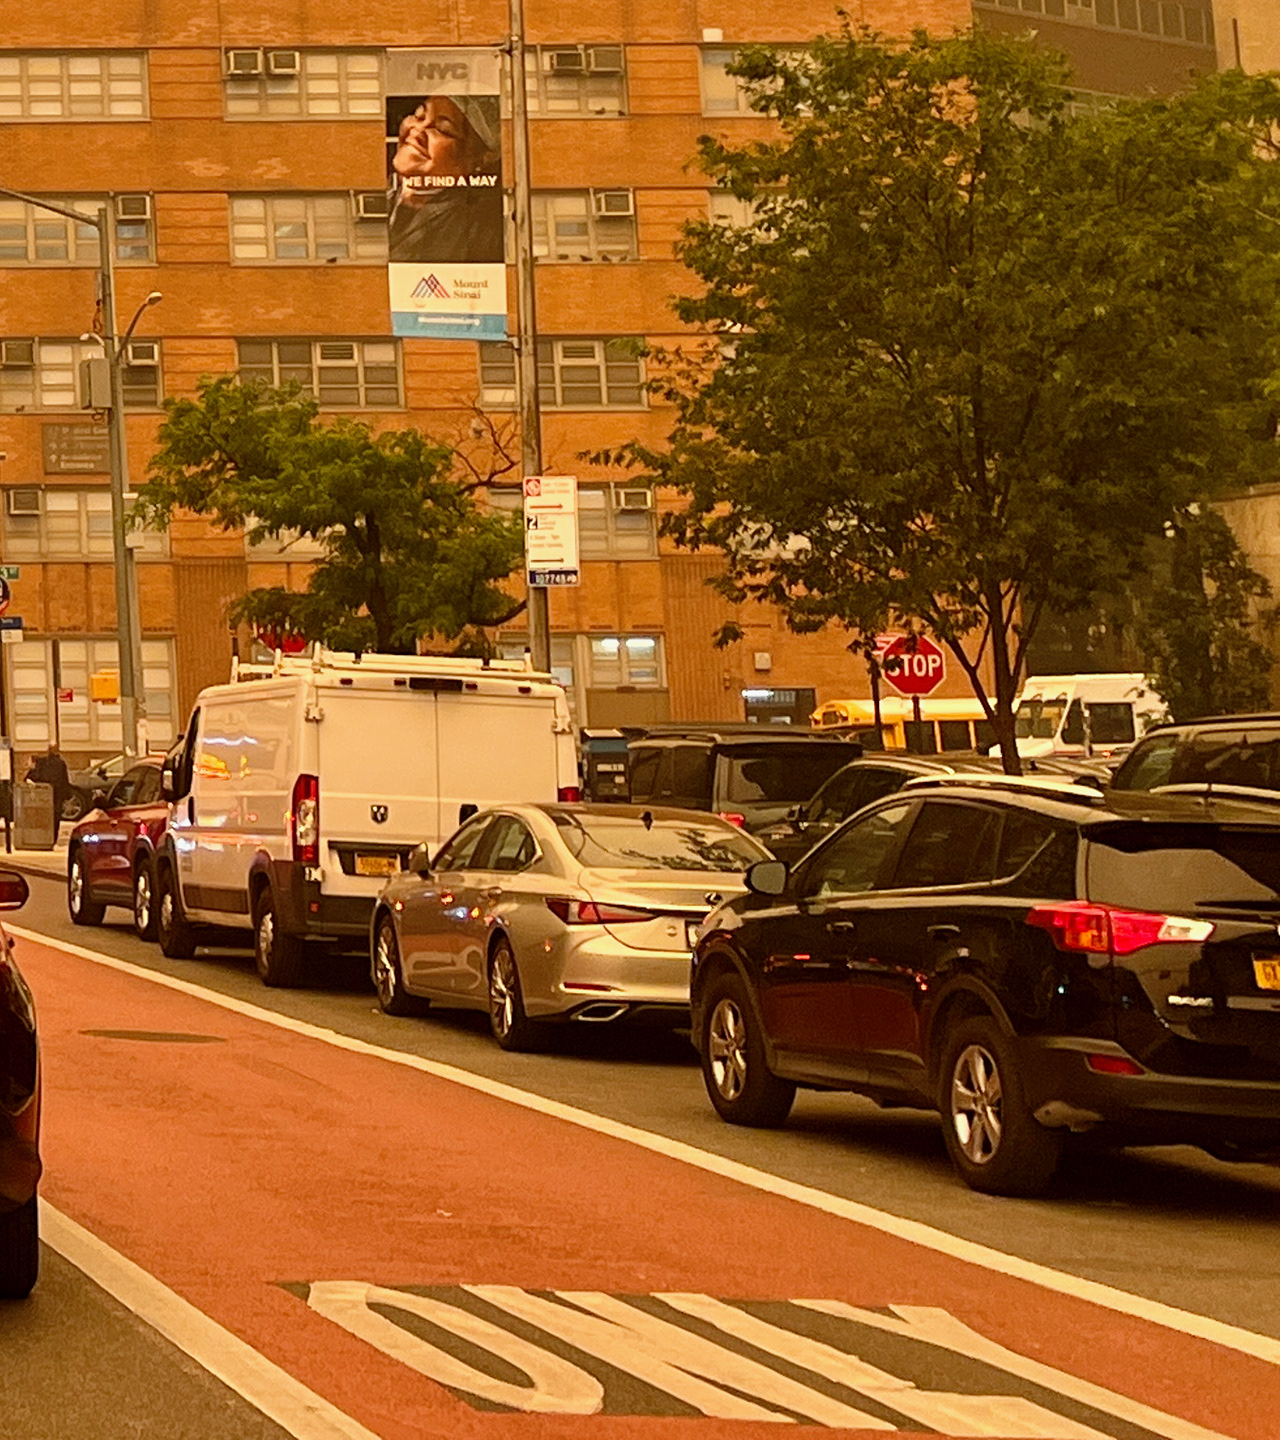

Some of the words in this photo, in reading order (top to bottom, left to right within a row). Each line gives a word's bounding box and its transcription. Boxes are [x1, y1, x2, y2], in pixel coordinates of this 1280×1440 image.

[417, 63, 468, 80] NYC
[402, 175, 422, 187] WE
[424, 176, 455, 187] FIND
[457, 176, 468, 187] A
[469, 175, 498, 187] WAY
[453, 279, 489, 289] Mount
[453, 290, 481, 299] Sinai
